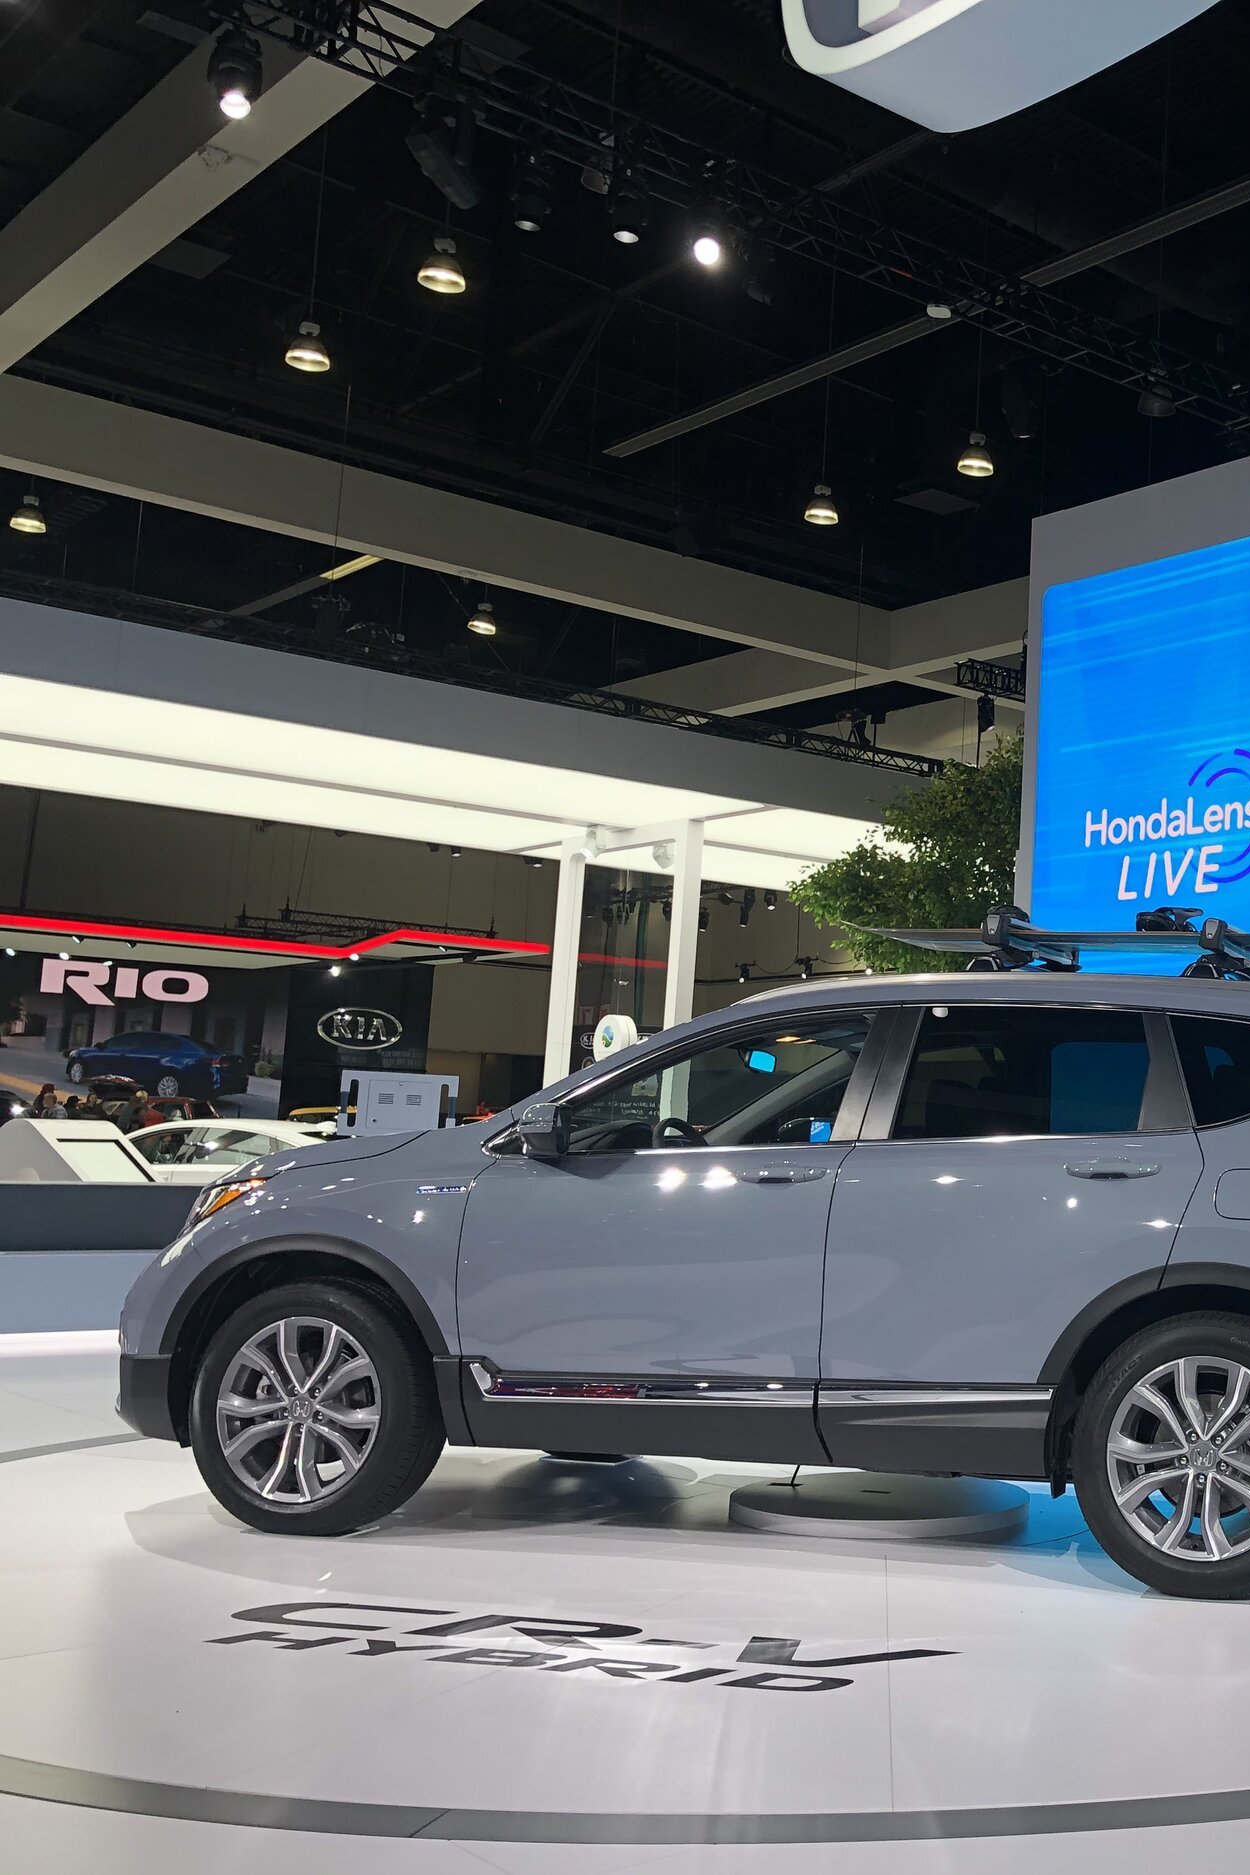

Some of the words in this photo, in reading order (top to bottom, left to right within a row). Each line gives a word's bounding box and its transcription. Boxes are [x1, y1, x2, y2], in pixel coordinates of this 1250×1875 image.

[1117, 844, 1223, 901] LIVE
[39, 957, 209, 1007] RIO
[331, 1013, 387, 1041] KIA
[202, 1630, 855, 1692] HYBRID
[230, 1602, 964, 1668] CR-V
